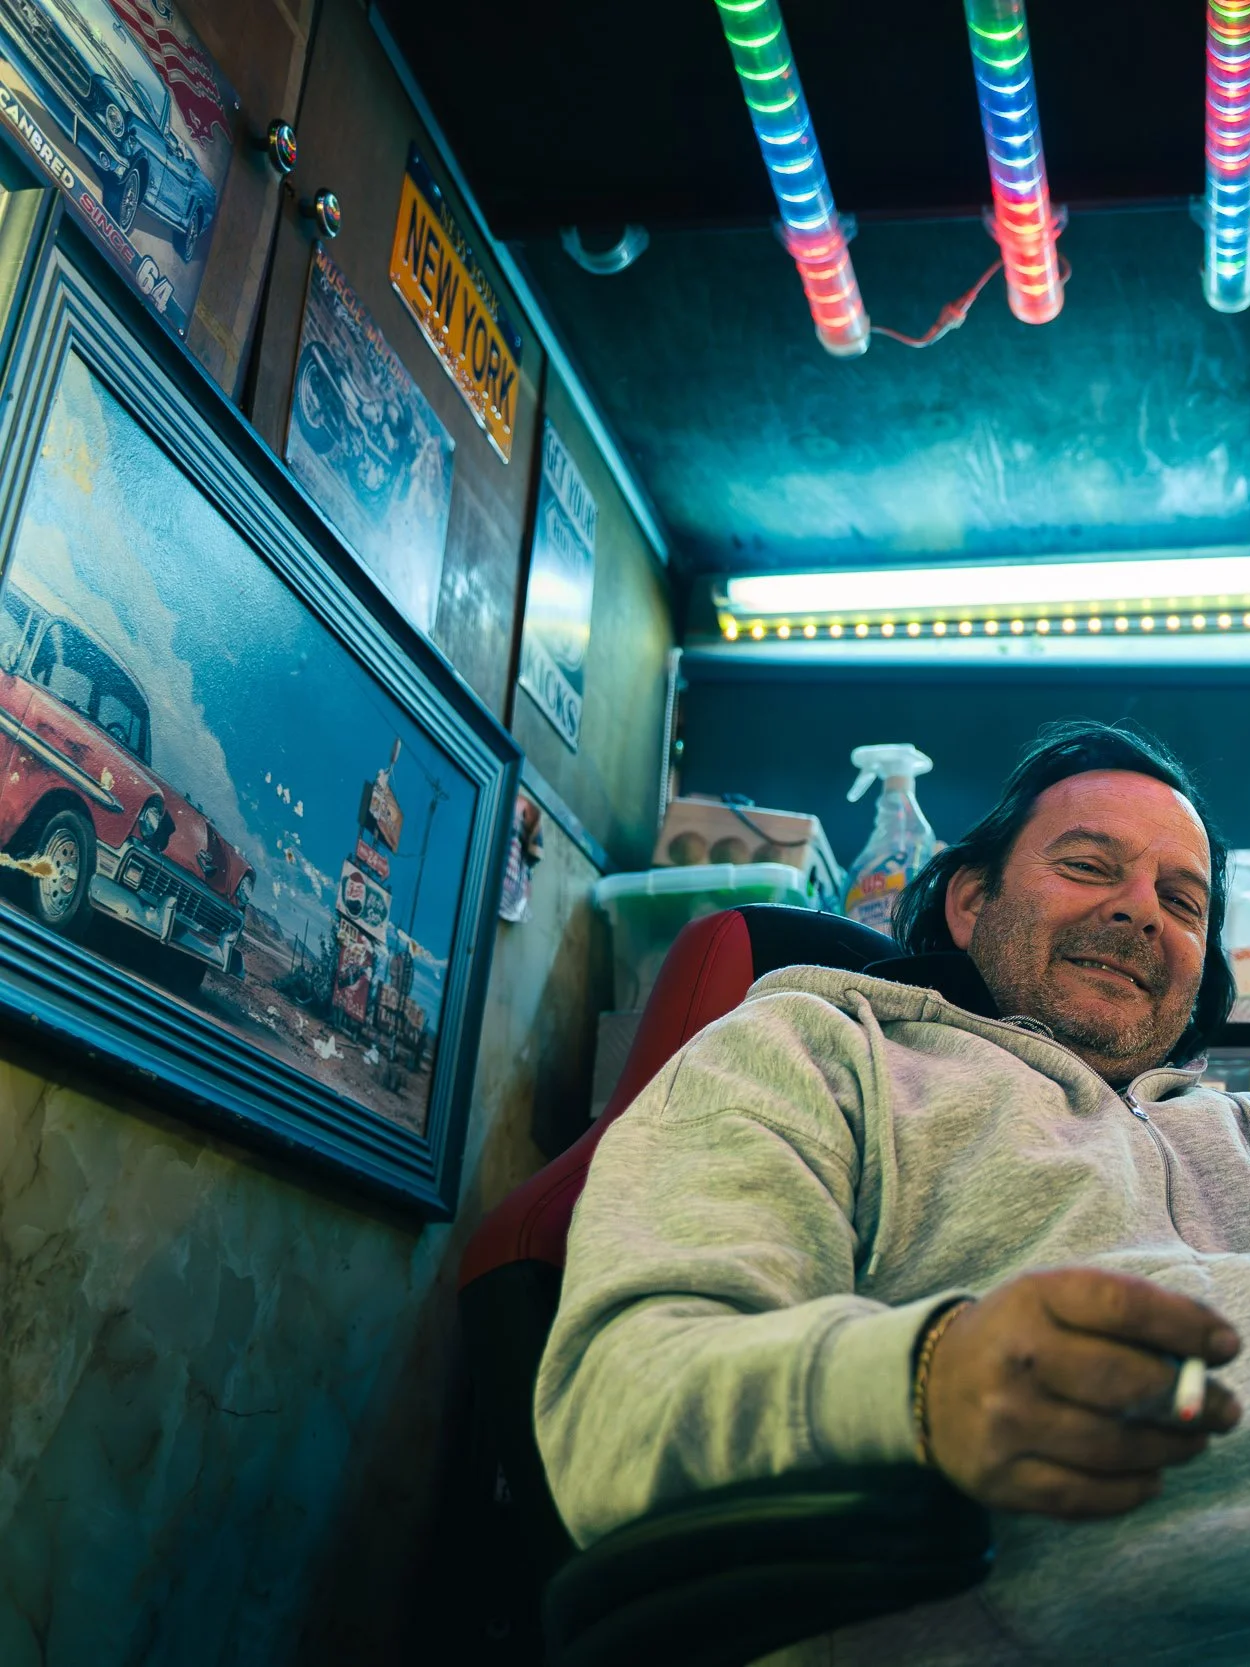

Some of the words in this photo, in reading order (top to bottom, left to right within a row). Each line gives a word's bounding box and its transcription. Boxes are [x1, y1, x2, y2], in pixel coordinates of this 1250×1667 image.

[80, 193, 134, 264] SINCE
[135, 254, 175, 313] 64
[402, 198, 460, 335] NEW
[459, 284, 516, 435] YORK
[526, 646, 577, 738] KICKS
